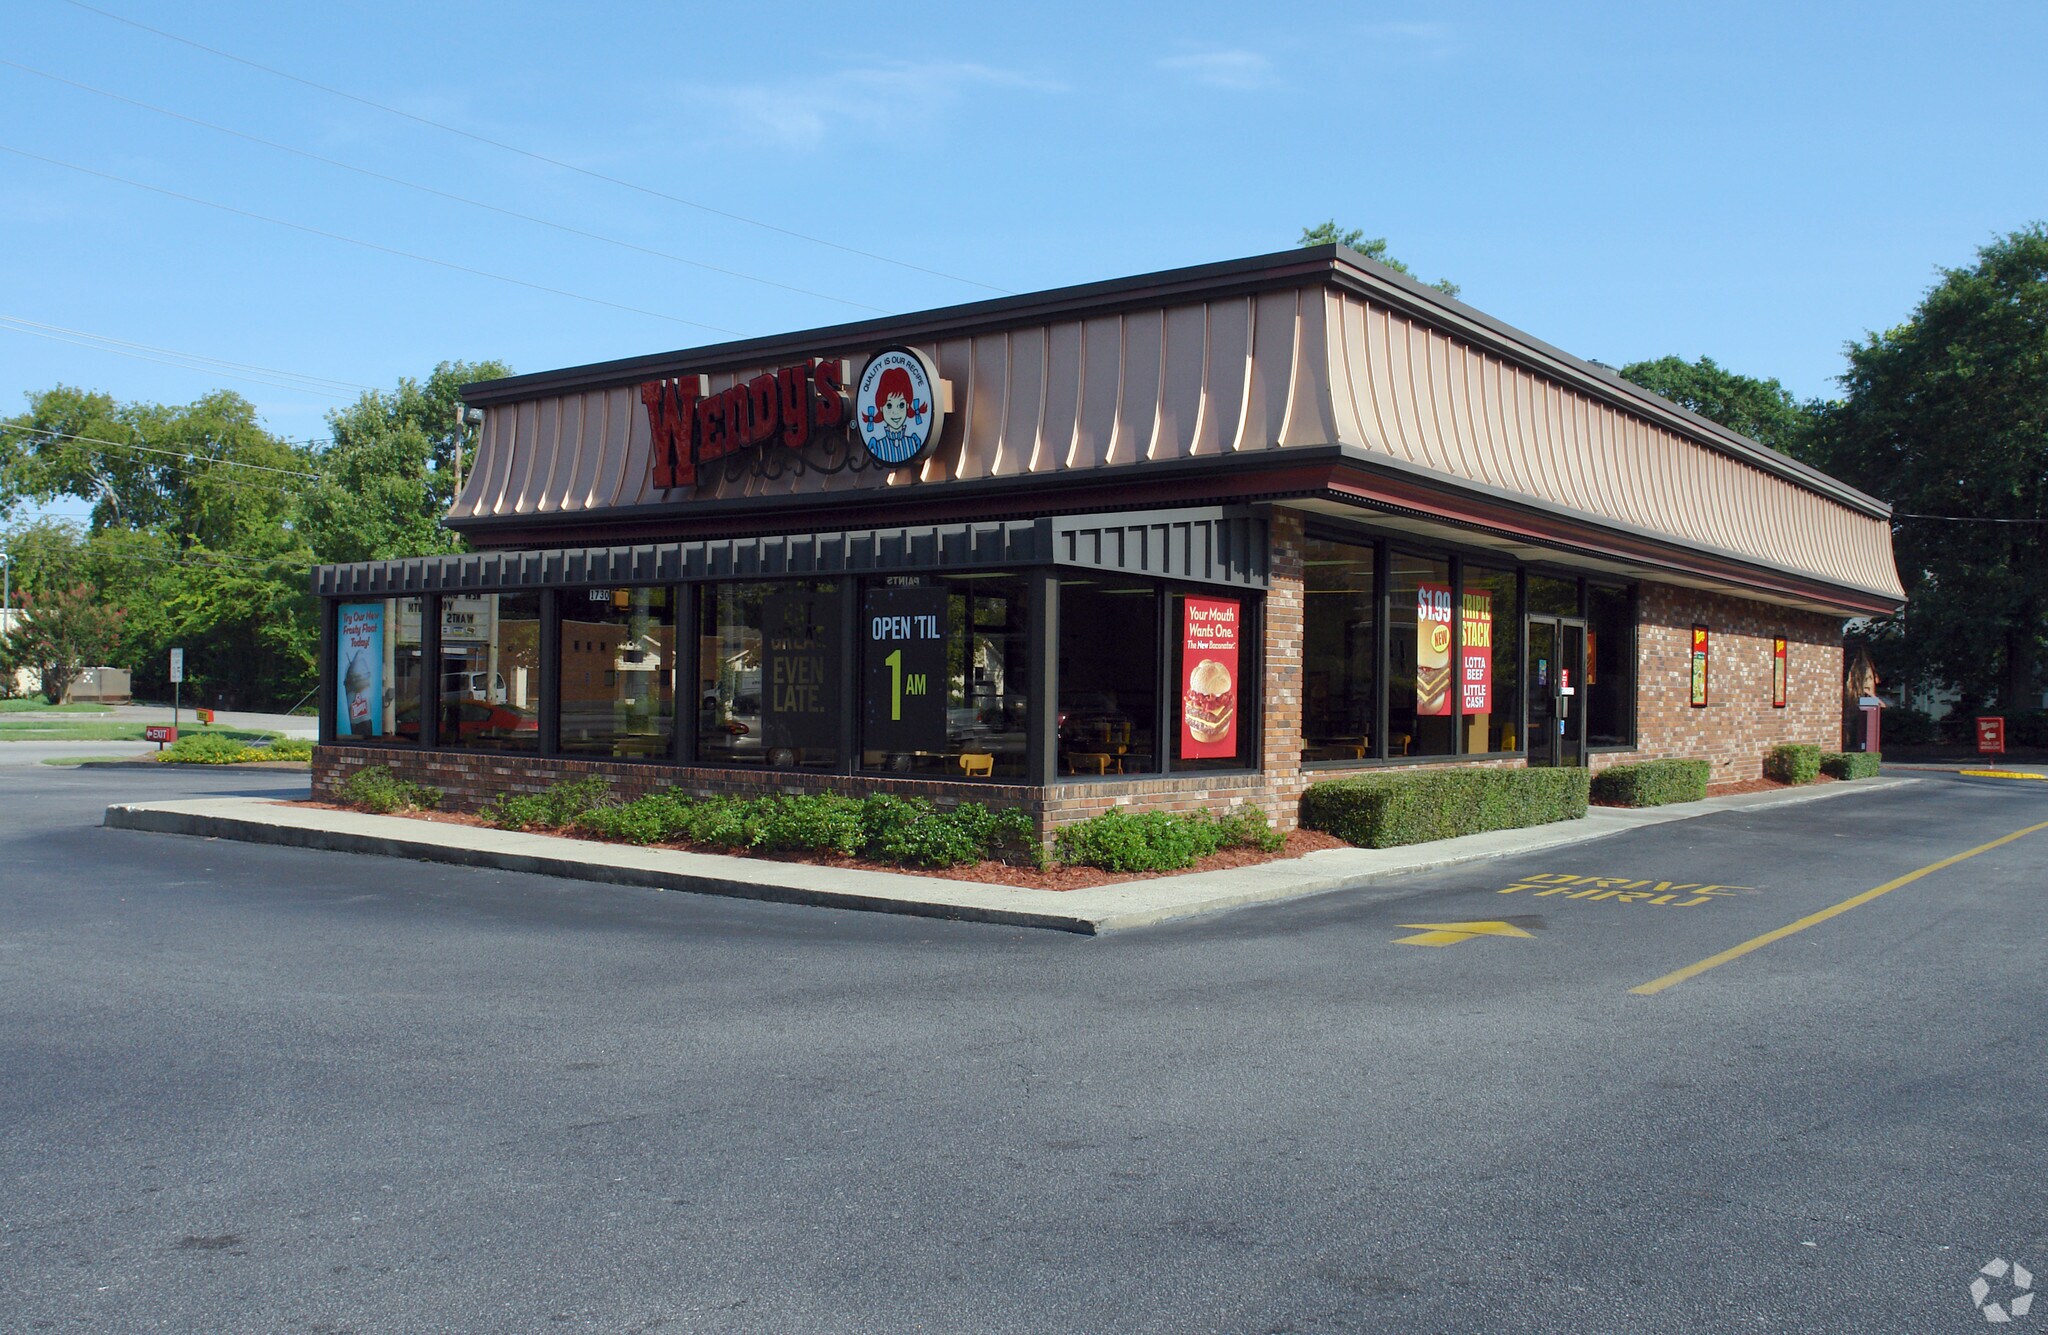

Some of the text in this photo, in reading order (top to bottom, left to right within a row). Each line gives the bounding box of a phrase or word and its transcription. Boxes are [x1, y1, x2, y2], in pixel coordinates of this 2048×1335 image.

[863, 356, 925, 392] QUALITY IS OUR RECIPE
[590, 590, 610, 600] 1730
[1418, 586, 1451, 622] $1.99
[1190, 606, 1234, 621] Your Mouth
[1462, 593, 1491, 620] TRIPLE
[872, 616, 910, 640] OPEN
[1190, 623, 1234, 637] Wants One.
[1434, 629, 1448, 647] NEW
[1462, 621, 1490, 647] STACK
[1187, 640, 1197, 649] The
[1197, 640, 1209, 649] New
[773, 656, 824, 684] EVEN
[1465, 656, 1486, 668] LOTTA
[885, 649, 902, 721] 1
[905, 674, 927, 695] AM
[1467, 669, 1484, 680] BEEF
[773, 684, 825, 712] LATE.
[1464, 684, 1486, 696] LITTLE
[1466, 696, 1484, 708] CASH
[153, 729, 167, 739] EXIT
[1497, 884, 1713, 907] THRU
[1519, 873, 1755, 897] DRIVE
